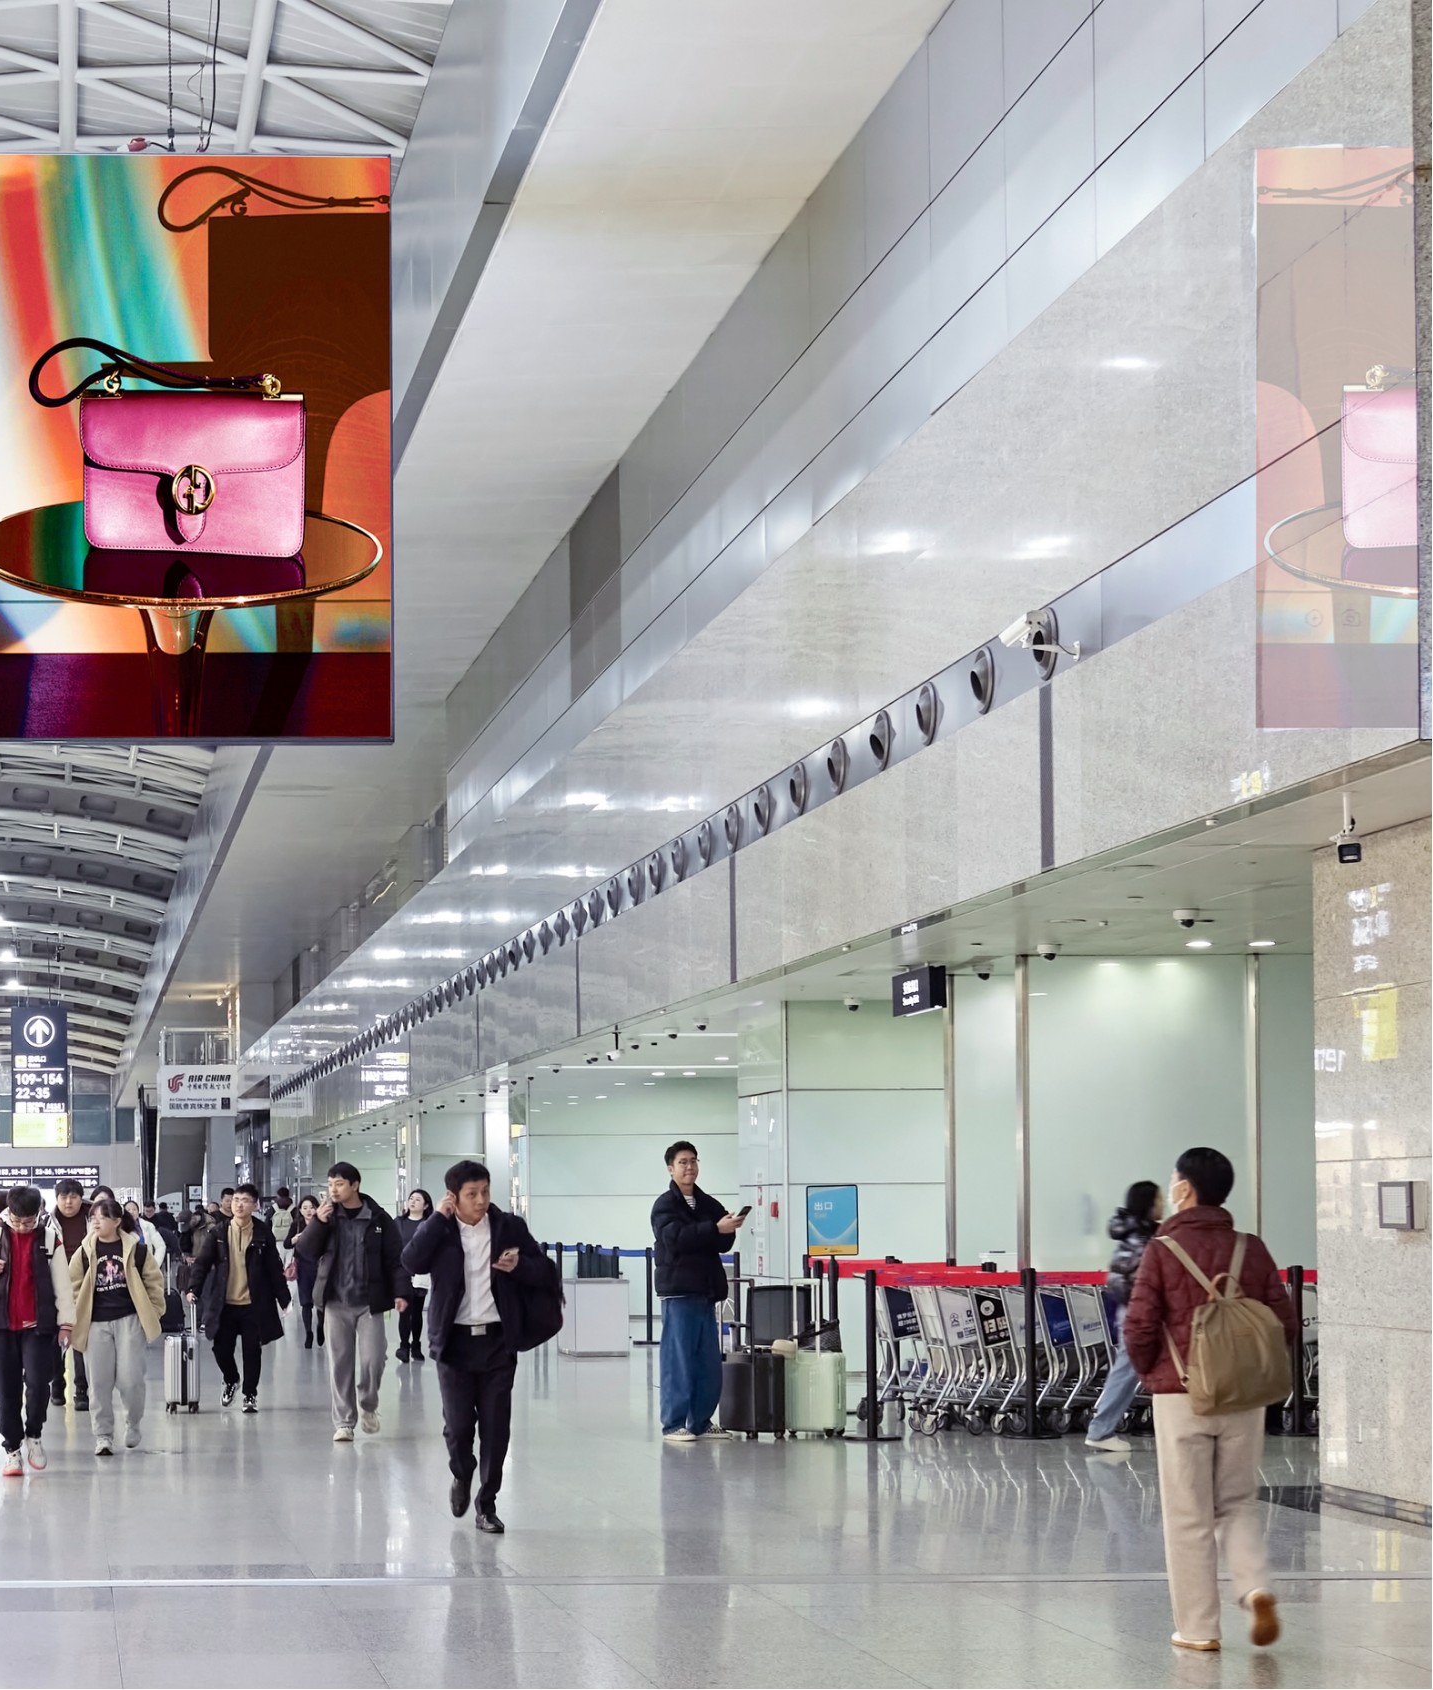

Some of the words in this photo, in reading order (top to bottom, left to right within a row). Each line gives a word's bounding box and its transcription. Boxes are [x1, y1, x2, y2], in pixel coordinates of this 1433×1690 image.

[15, 1073, 64, 1085] 109-154
[15, 1087, 51, 1099] 22-35
[814, 1202, 833, 1211] 出口
